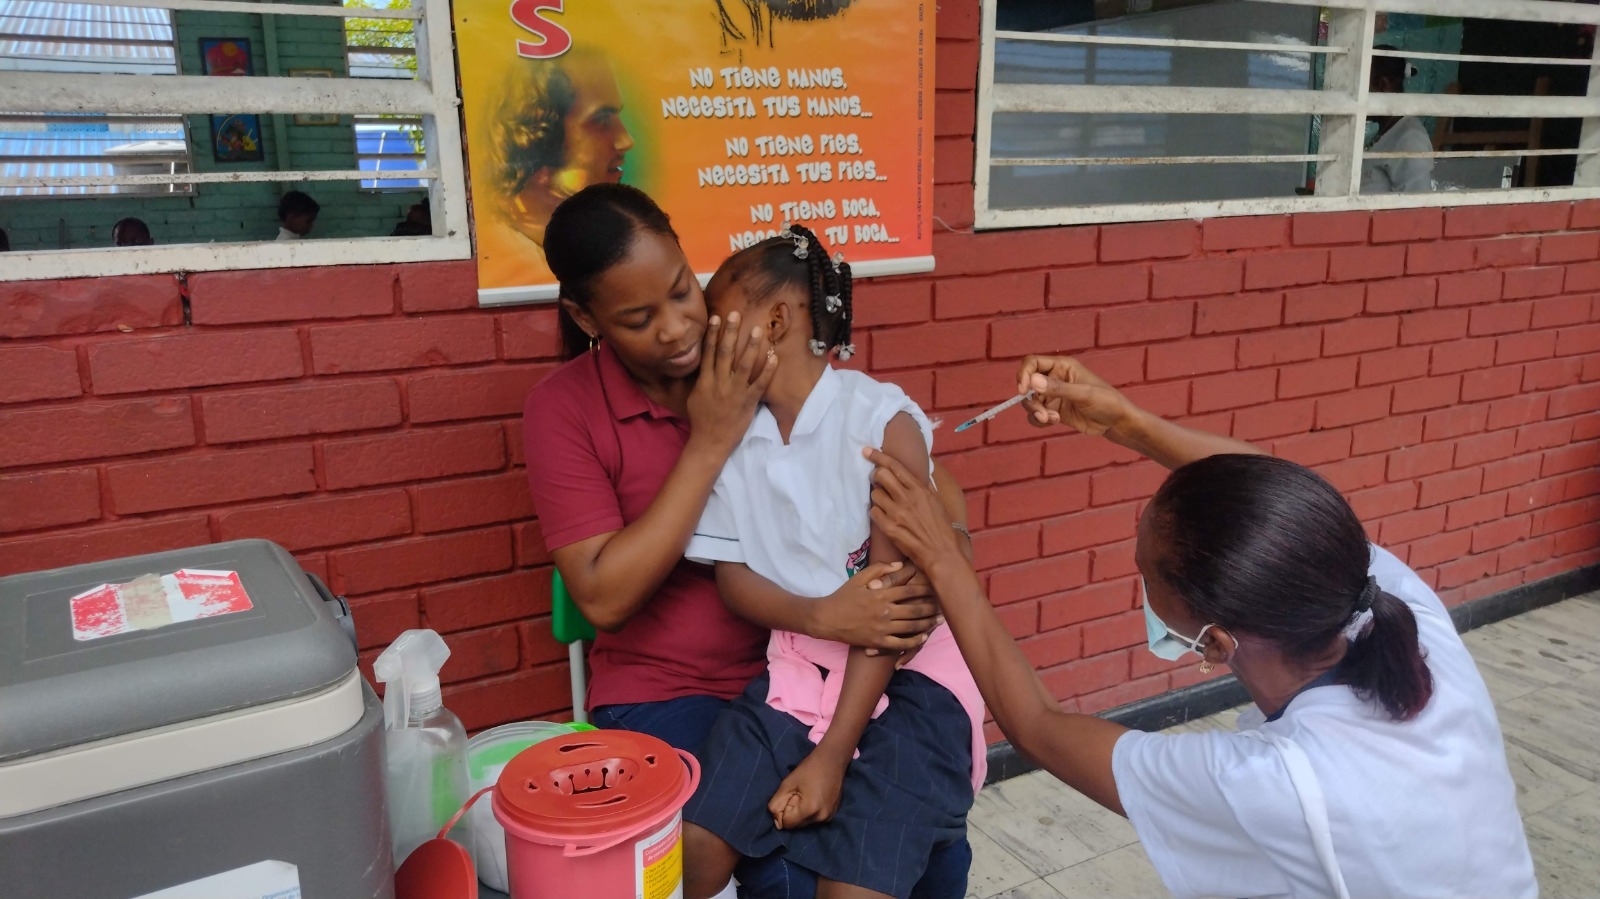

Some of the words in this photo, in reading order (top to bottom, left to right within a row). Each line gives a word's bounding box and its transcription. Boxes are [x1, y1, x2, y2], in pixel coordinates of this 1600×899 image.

[509, 0, 572, 59] S
[689, 67, 714, 88] NO
[787, 67, 847, 90] MANOS,
[762, 95, 801, 117] TUS
[725, 136, 749, 157] NO
[796, 161, 833, 183] TUS
[750, 203, 774, 223] NO
[842, 197, 881, 218] BOCA,
[824, 224, 849, 246] TU
